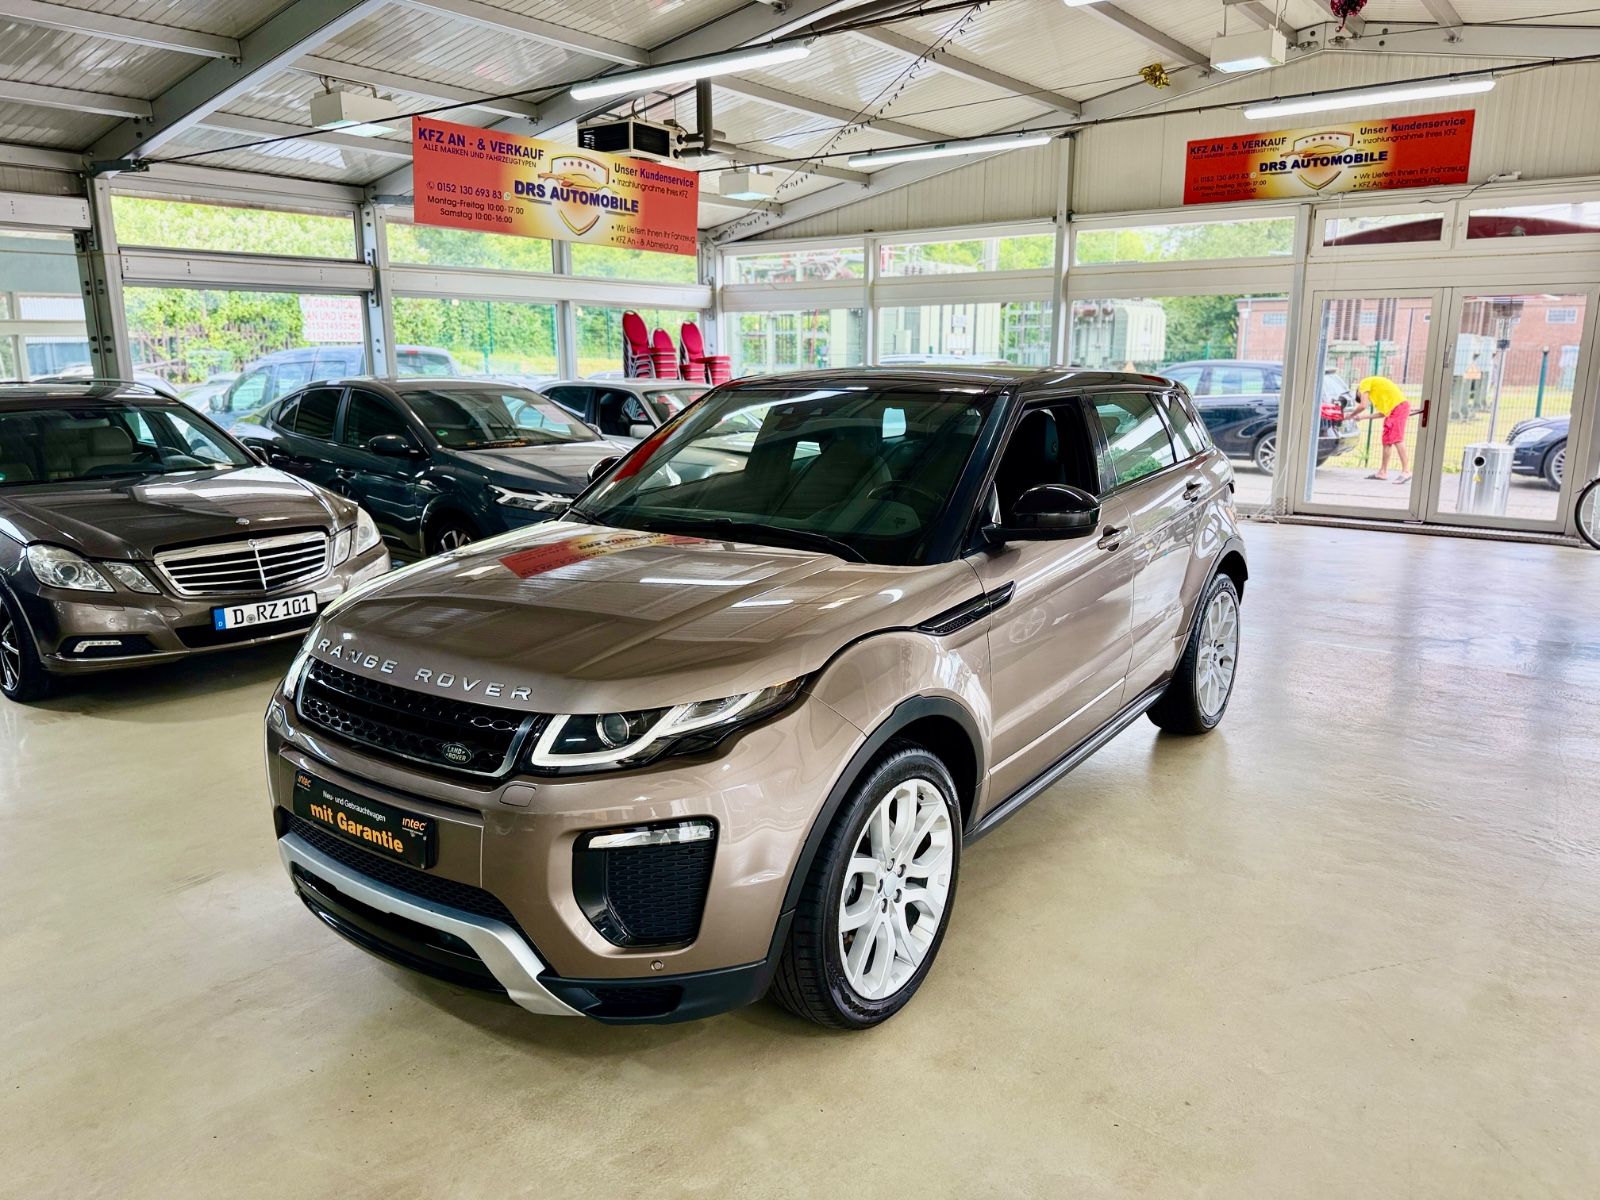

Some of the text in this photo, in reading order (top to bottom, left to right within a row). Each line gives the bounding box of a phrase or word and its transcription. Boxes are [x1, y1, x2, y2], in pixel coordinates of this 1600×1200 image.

[1360, 117, 1466, 135] Unser Kundenservice
[1444, 128, 1457, 137] KFZ
[418, 127, 444, 144] KFZ
[448, 133, 466, 147] AN
[477, 138, 486, 151] &
[490, 140, 544, 160] VERKAUF
[1190, 145, 1209, 154] KFZ
[1210, 144, 1223, 153] AN
[1232, 142, 1238, 150] &
[1242, 137, 1287, 149] VERKAUF
[423, 143, 537, 168] ALLE MARKEN UND FAHRZEUGTYPEN
[1260, 151, 1388, 173] DRS AUTOMOBILE
[614, 162, 694, 188] Unser Kundenservice
[1431, 165, 1466, 174] Fahrzeug
[437, 182, 502, 199] 0152 130 693 83
[514, 180, 639, 213] DRS AUTOMOBILE
[679, 190, 688, 199] KFZ
[427, 195, 485, 211] Montag-Freitag
[440, 208, 472, 220] Samstag
[616, 224, 626, 232] Wir
[671, 231, 696, 244] Fahrzeug
[616, 236, 626, 244] KFZ
[627, 237, 636, 245] An
[646, 239, 679, 252] Abmeldung
[233, 609, 244, 625] D
[317, 638, 533, 701] RANGE ROVER
[447, 746, 463, 755] LAND
[448, 752, 467, 761] ROVER
[322, 790, 386, 822] Neu- und Gebrauchtwagen
[310, 803, 404, 853] mit Garantie
[402, 817, 427, 831] intec
